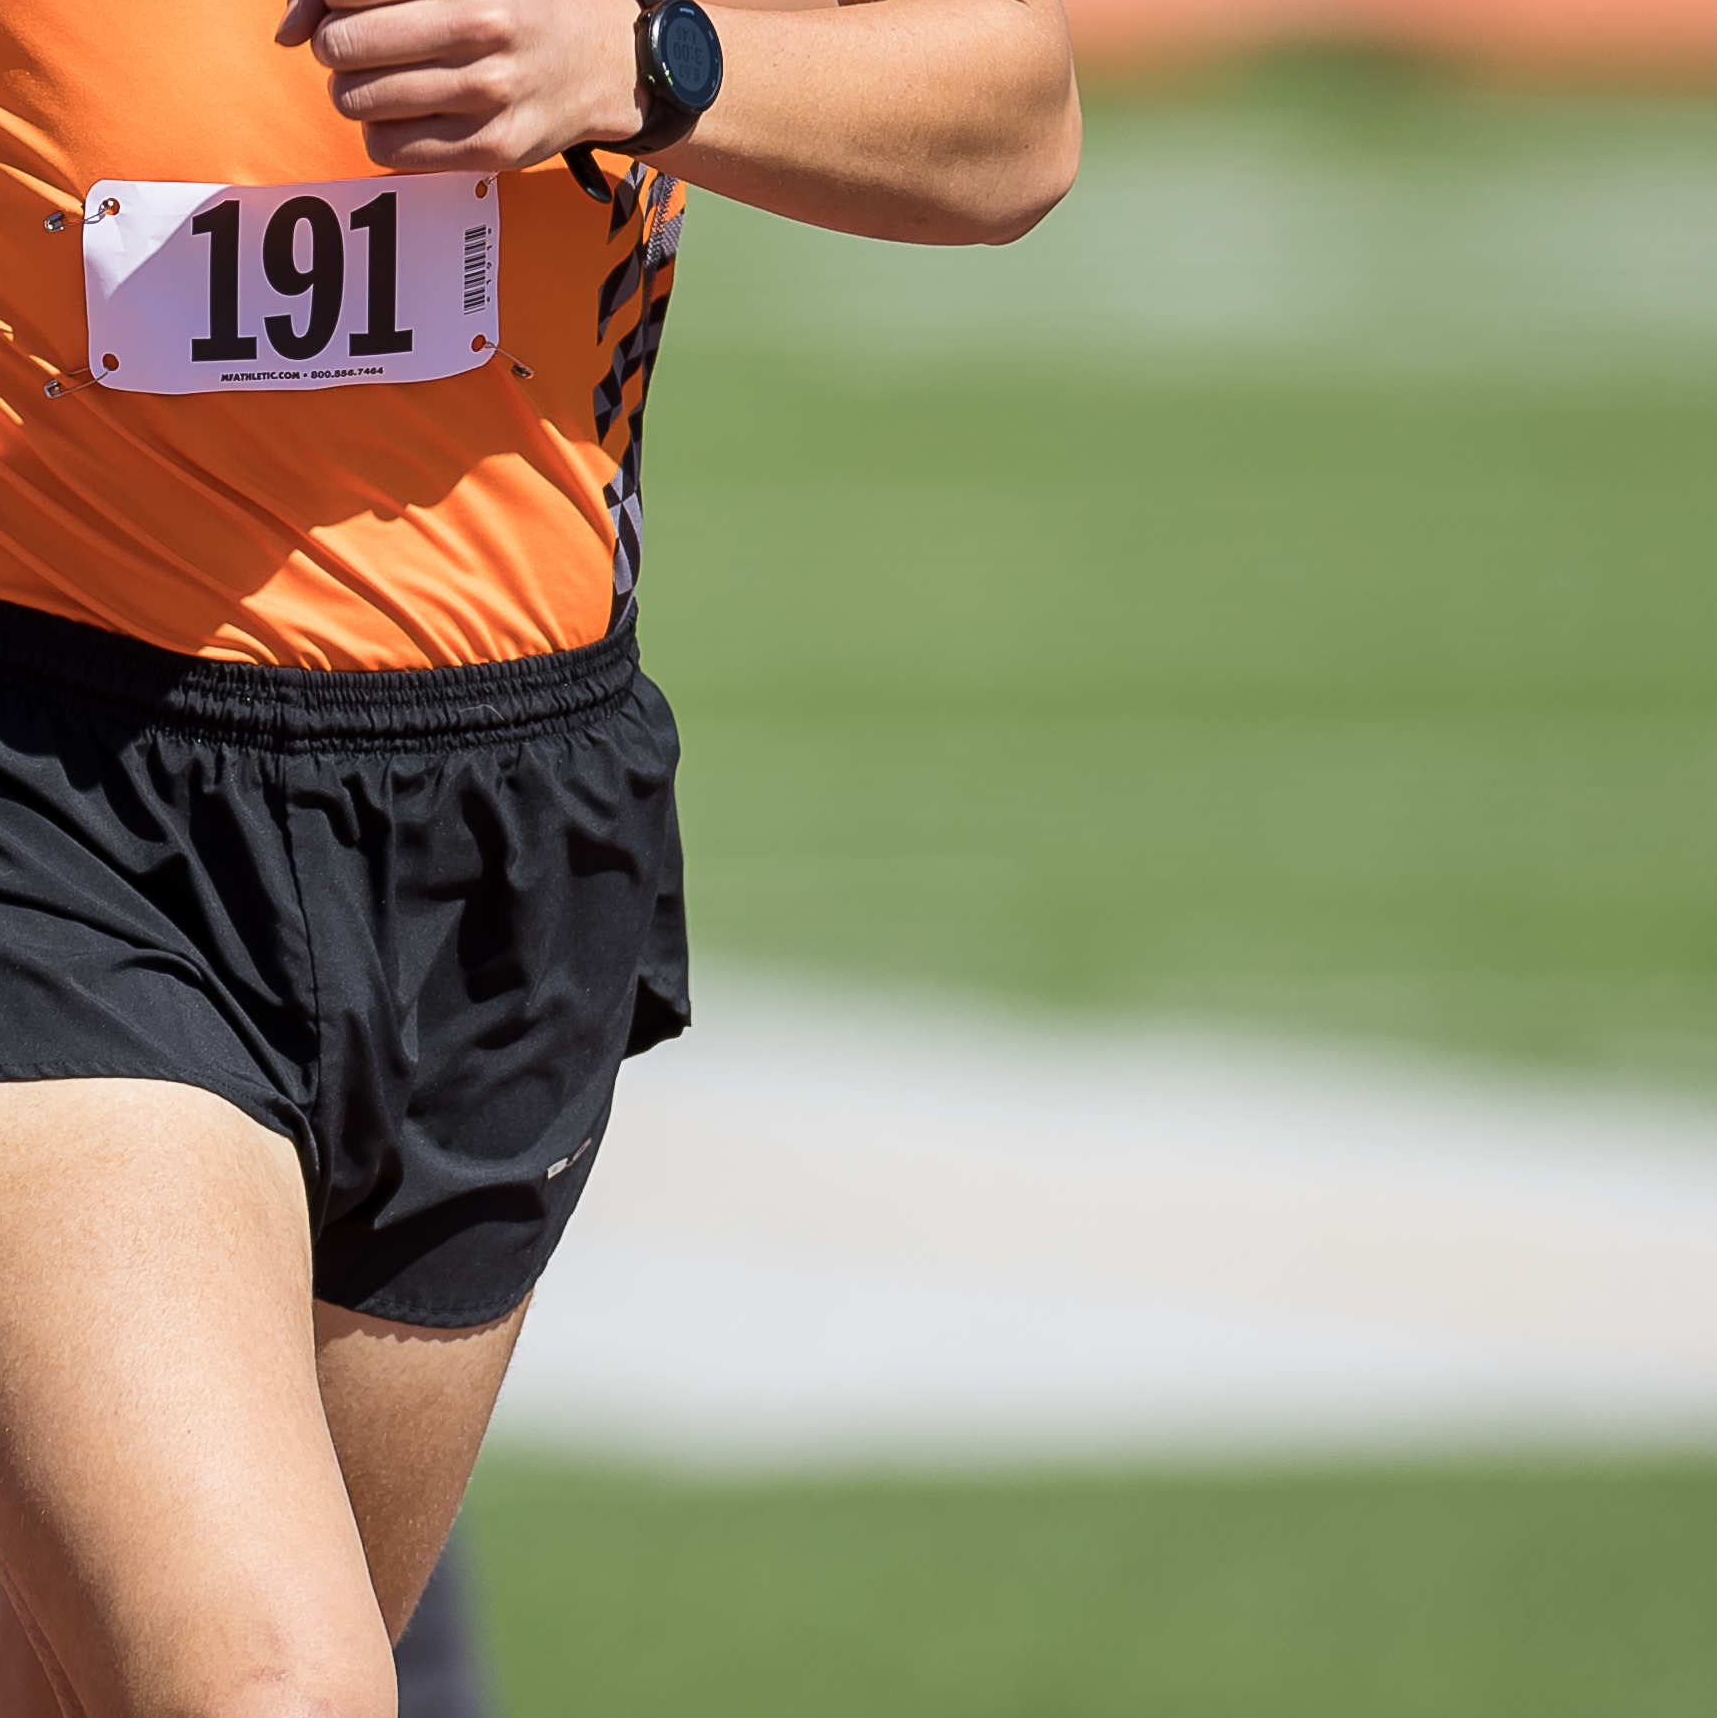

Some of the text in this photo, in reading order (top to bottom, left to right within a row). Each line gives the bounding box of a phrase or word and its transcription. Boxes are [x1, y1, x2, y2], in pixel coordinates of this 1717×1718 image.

[191, 191, 413, 363] 191
[220, 366, 384, 382] MFATHLETIC.COM 800.556.7464
